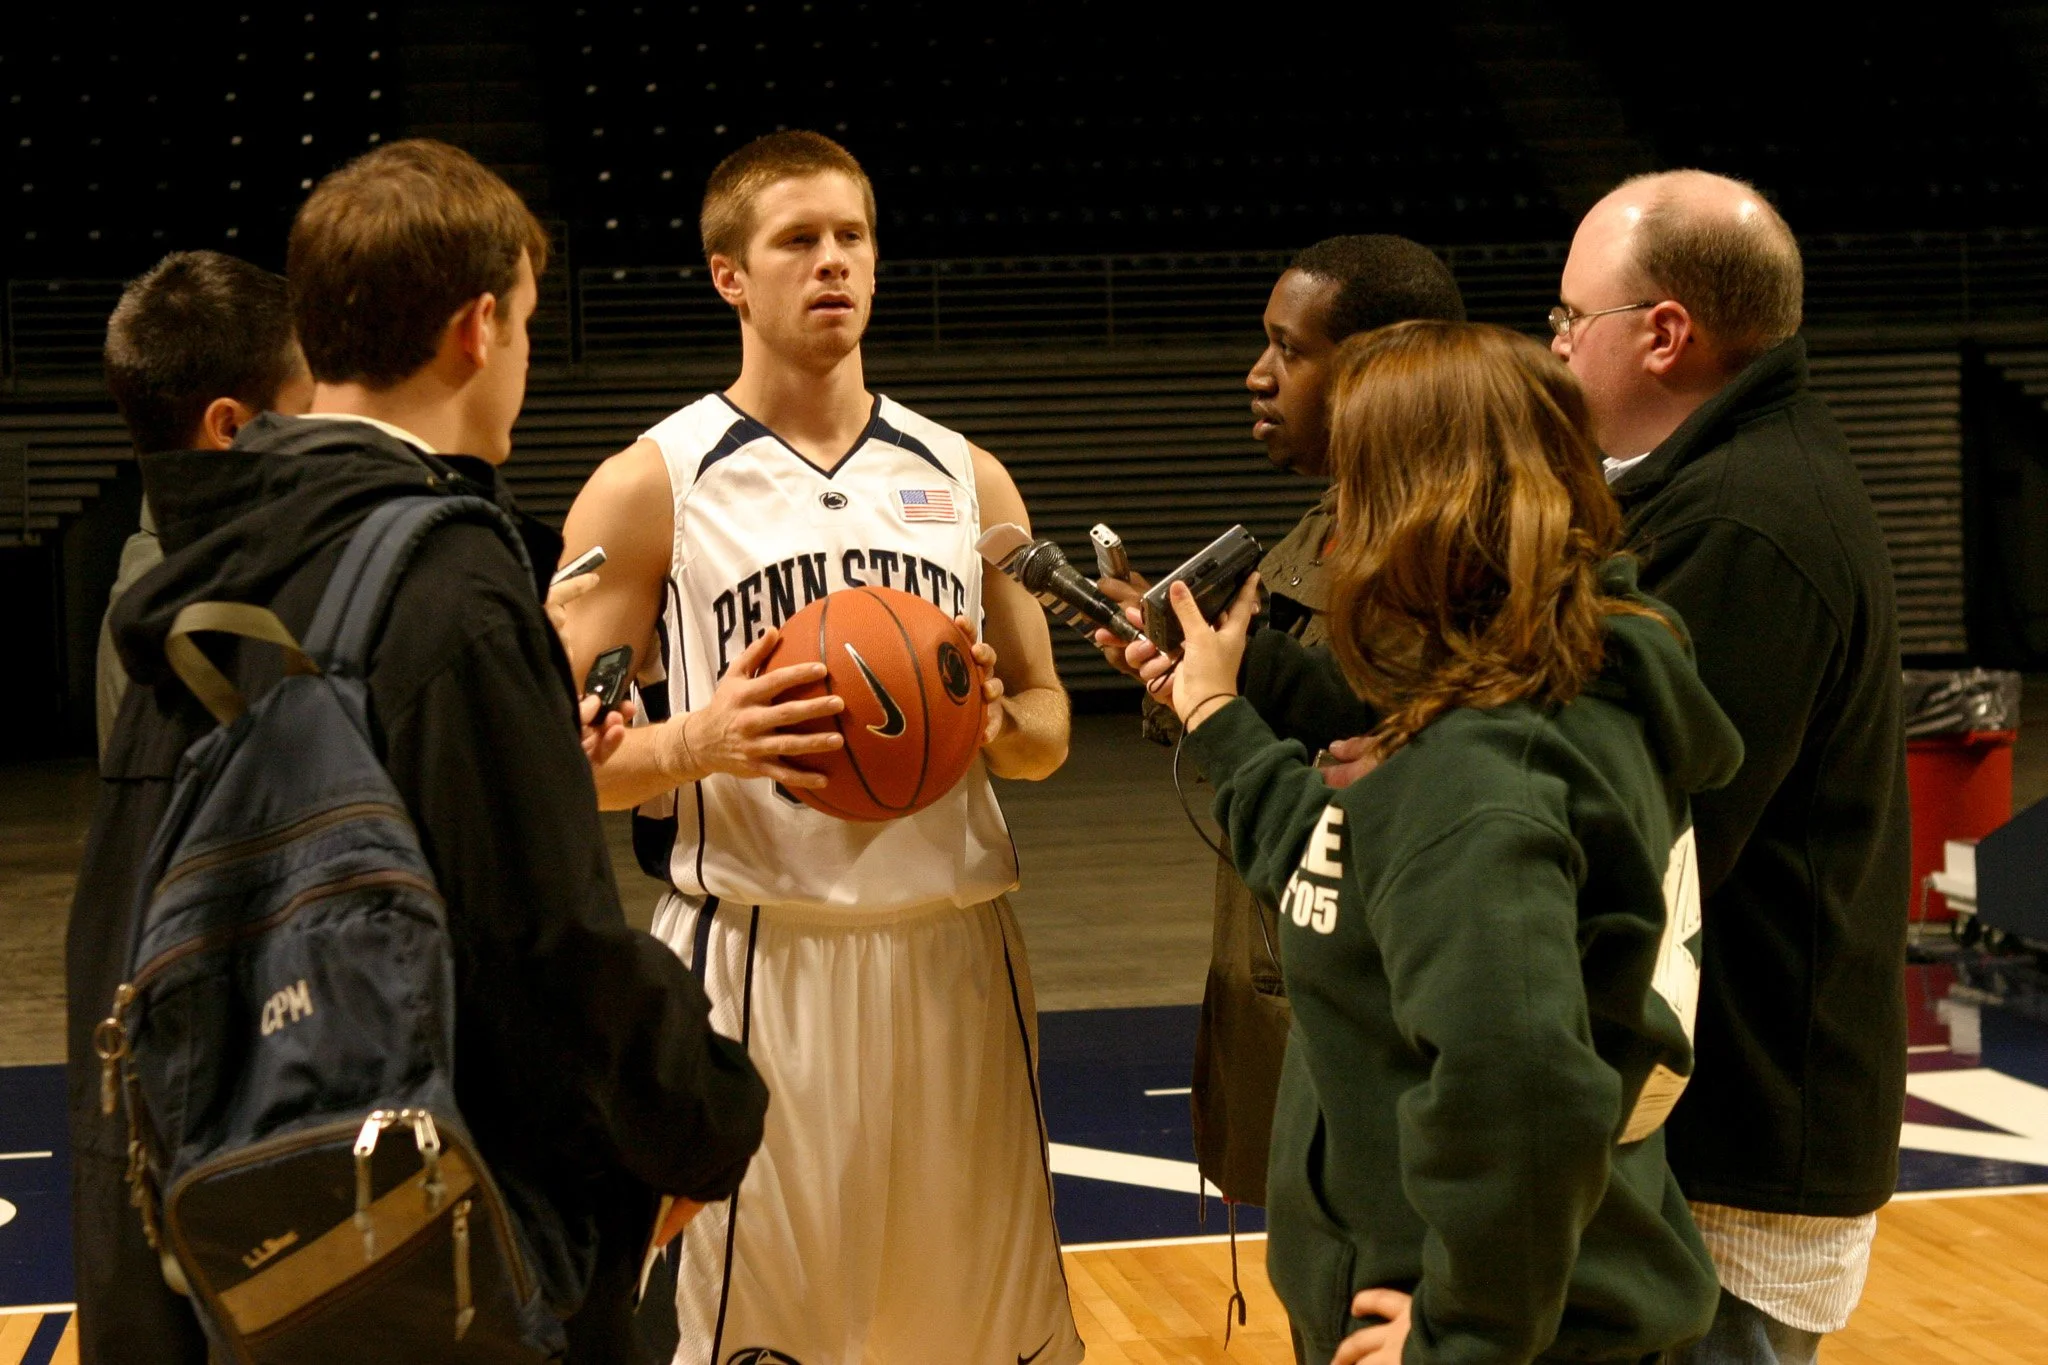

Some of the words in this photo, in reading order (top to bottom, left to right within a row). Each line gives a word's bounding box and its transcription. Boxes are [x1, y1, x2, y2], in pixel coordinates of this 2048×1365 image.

[712, 551, 828, 680] PENN
[842, 549, 966, 622] STATE
[1300, 803, 1345, 880] E
[261, 979, 314, 1036] CPM
